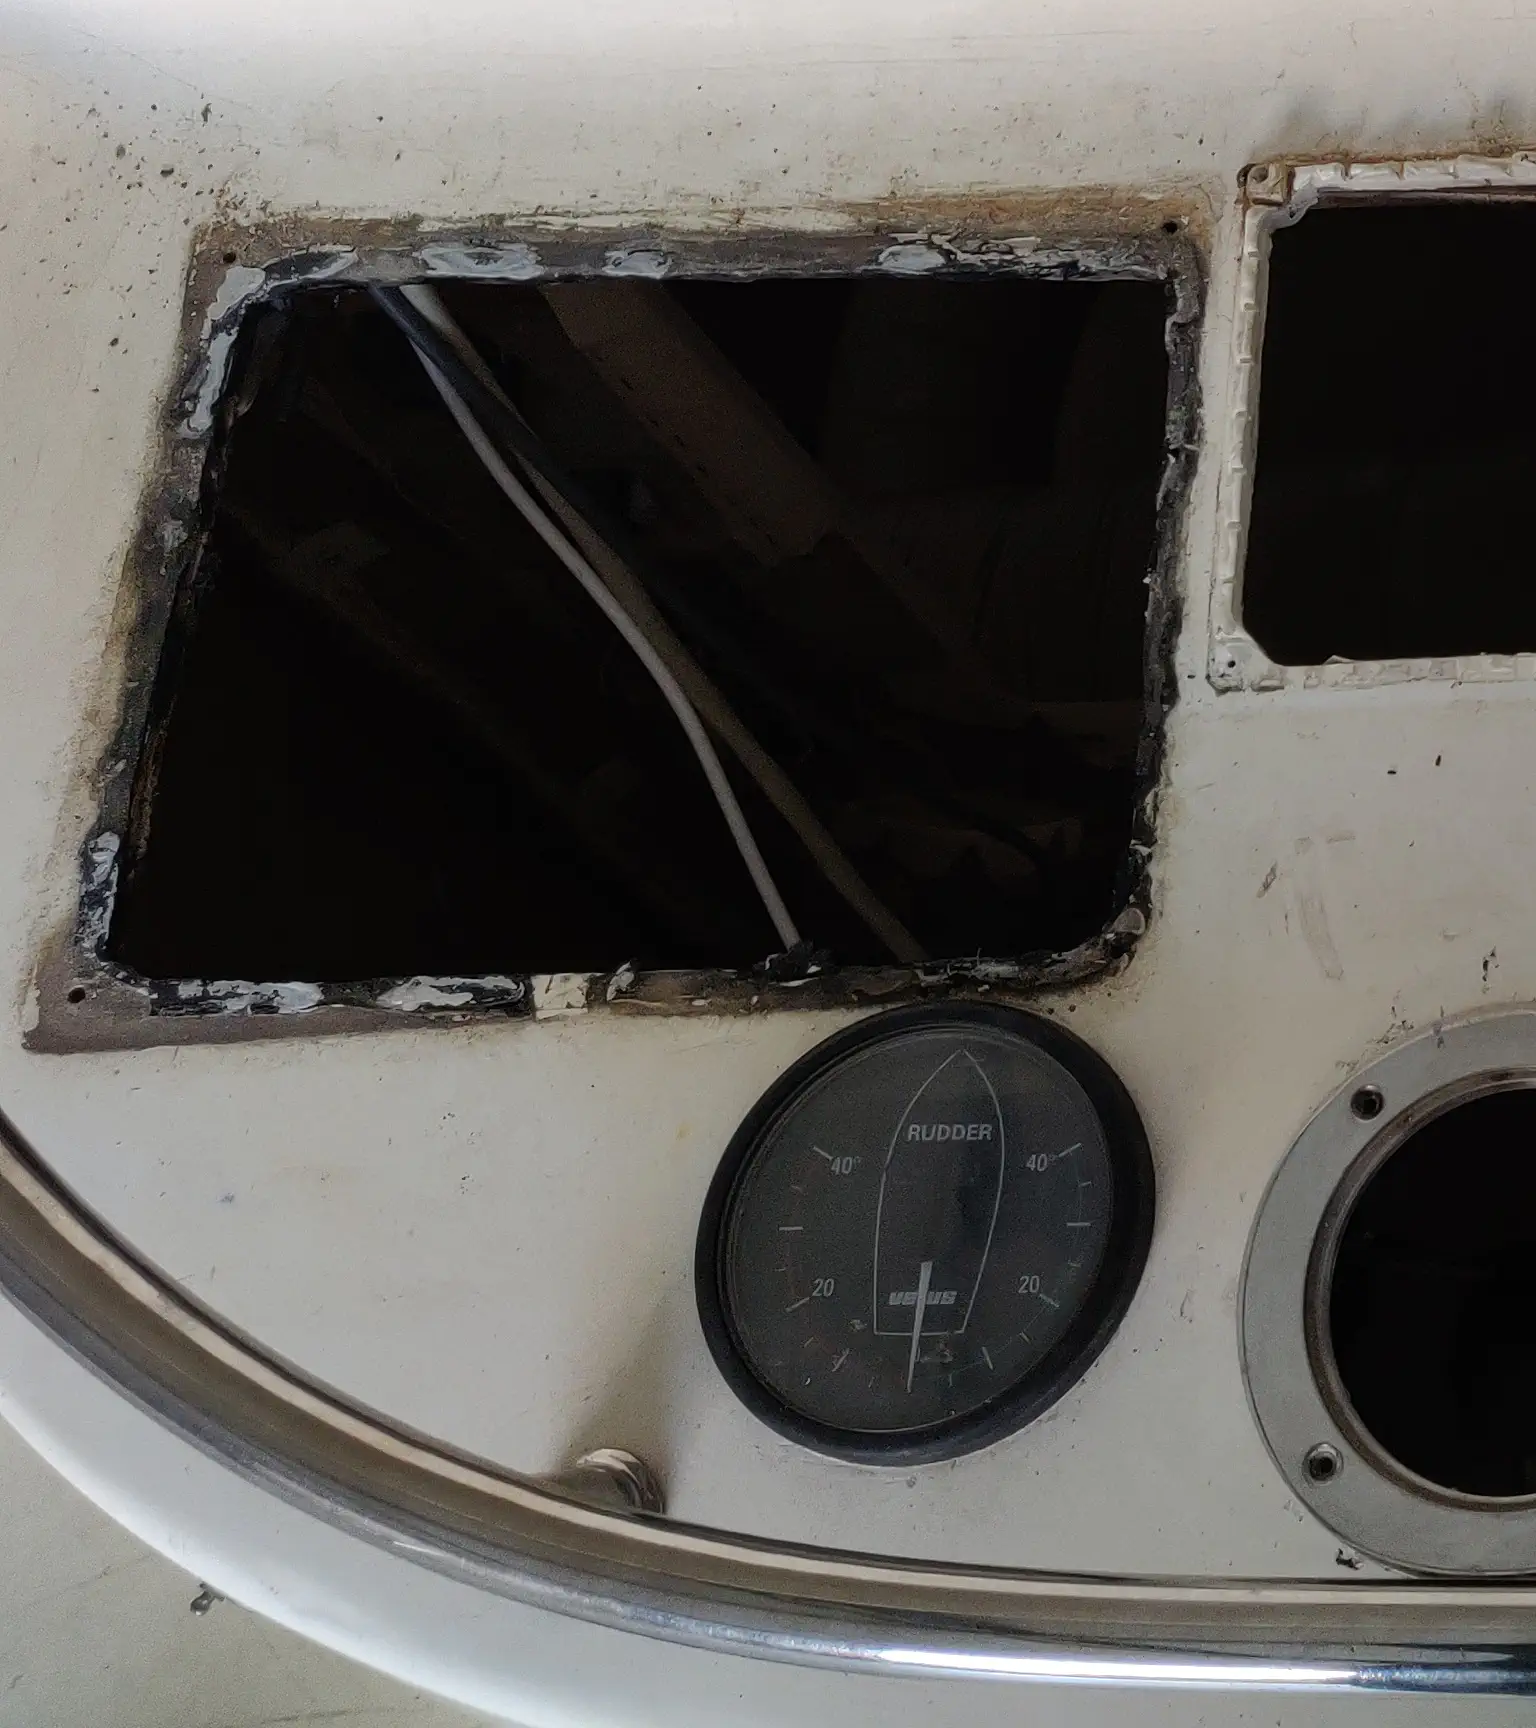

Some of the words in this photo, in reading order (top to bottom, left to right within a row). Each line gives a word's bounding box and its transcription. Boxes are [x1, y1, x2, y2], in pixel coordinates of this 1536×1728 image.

[907, 1123, 993, 1142] RUDDER
[812, 1278, 835, 1298] 20
[1018, 1275, 1041, 1295] 20
